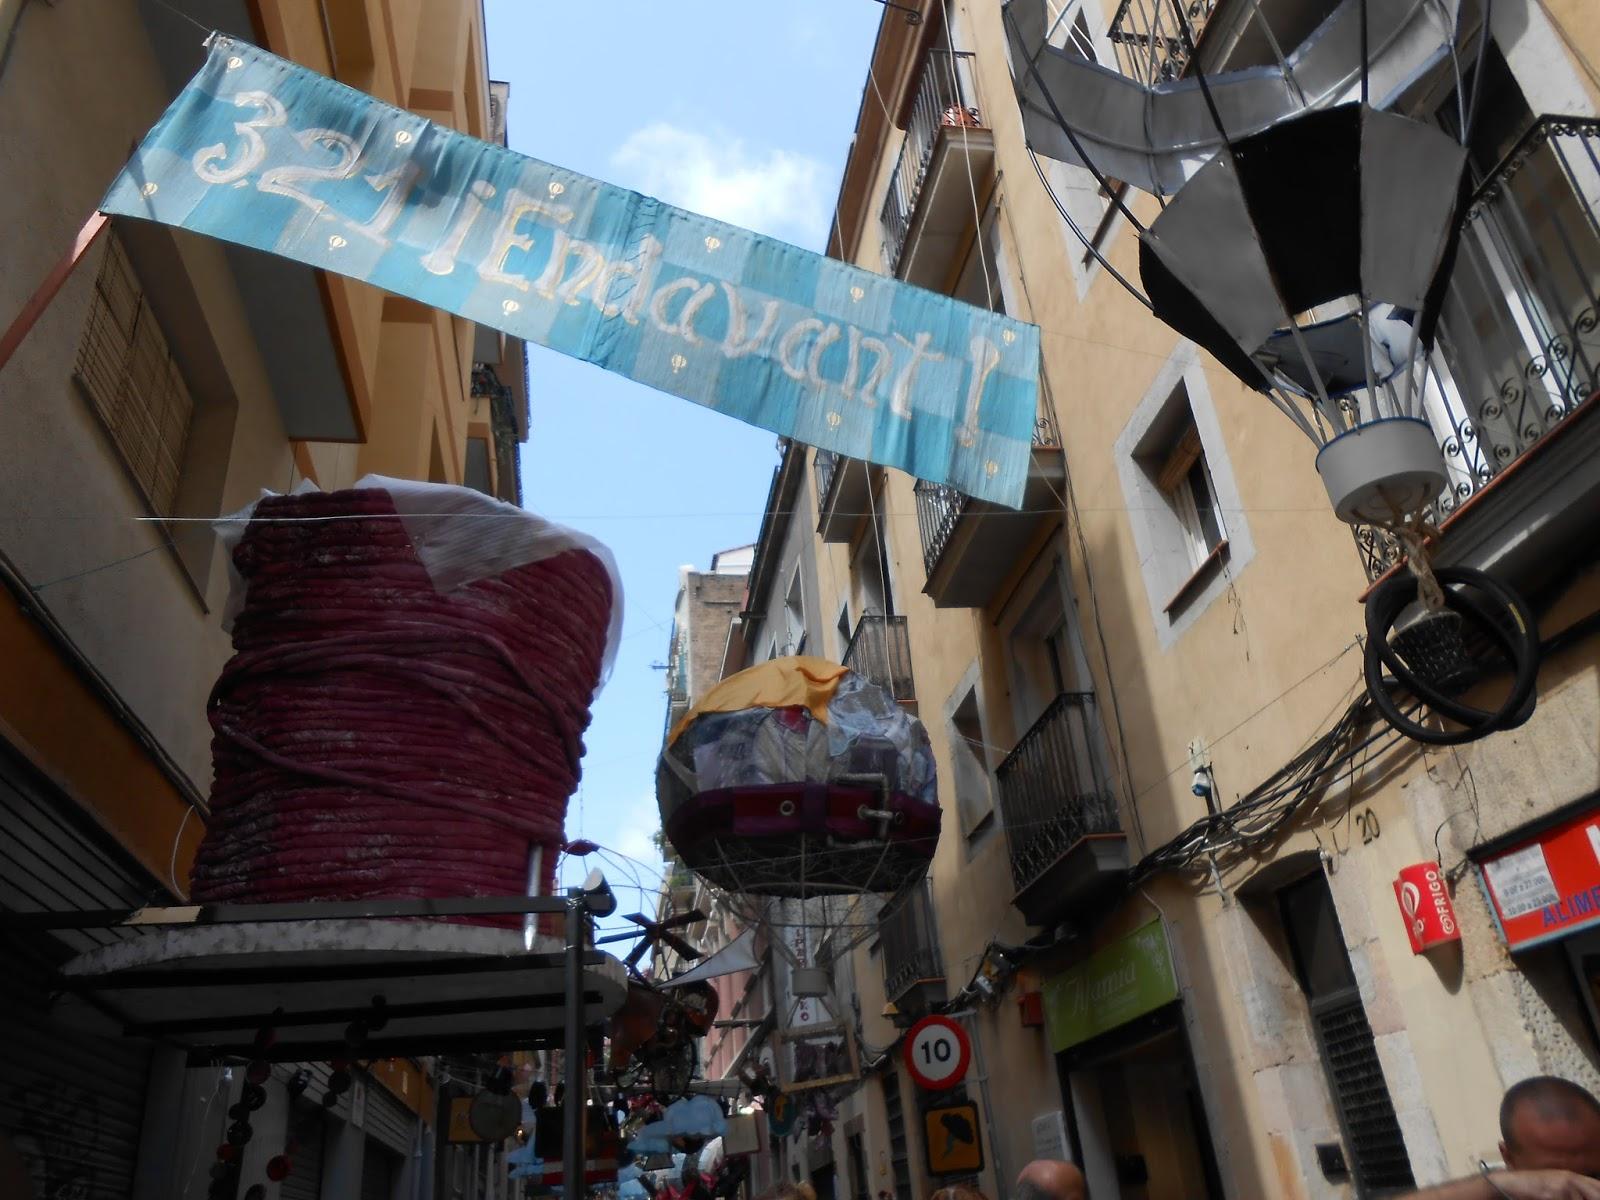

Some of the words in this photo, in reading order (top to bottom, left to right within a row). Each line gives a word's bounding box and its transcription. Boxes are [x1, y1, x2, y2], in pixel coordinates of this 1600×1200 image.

[1355, 807, 1381, 846] 20
[1424, 869, 1451, 915] FRIGO
[920, 1037, 952, 1065] 10
